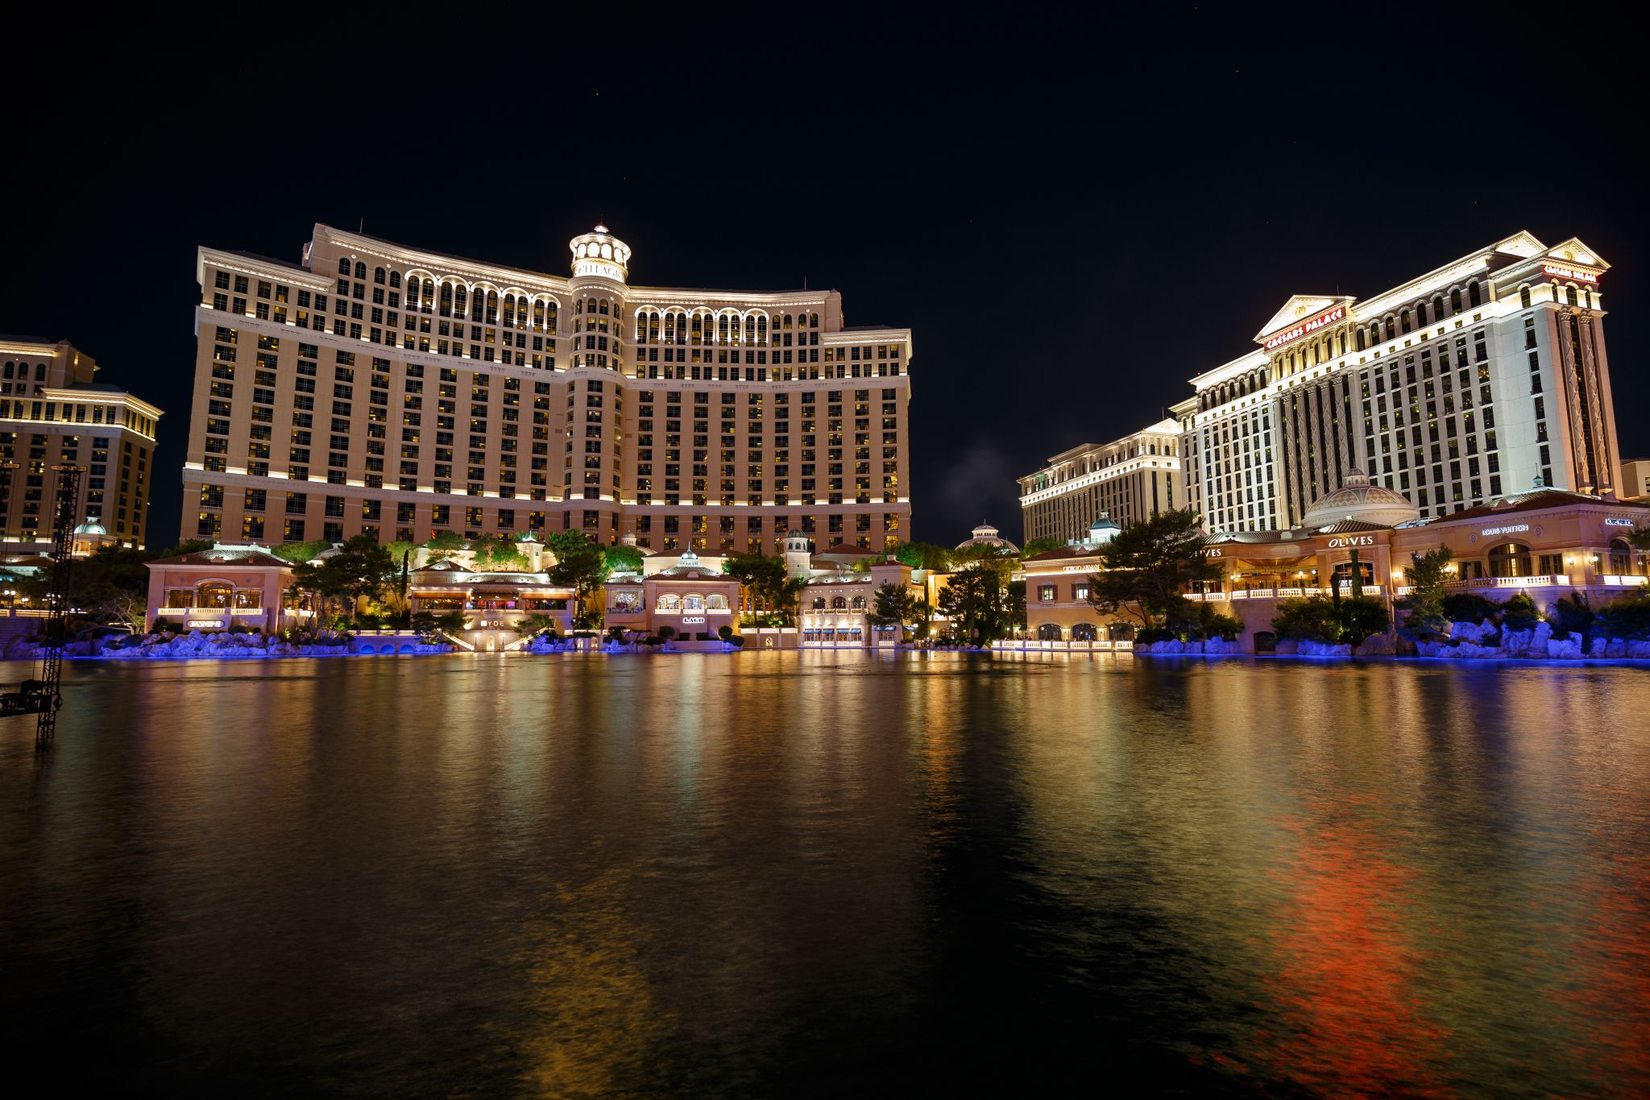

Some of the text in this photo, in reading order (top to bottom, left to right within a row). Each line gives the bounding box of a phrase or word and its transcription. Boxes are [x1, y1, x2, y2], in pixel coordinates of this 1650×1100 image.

[1544, 265, 1597, 283] CAESARS PALACE
[1266, 309, 1343, 349] CAESARS PALACE
[1482, 524, 1529, 536] LOUIS VUITTON
[1328, 535, 1374, 548] OLIVES
[683, 616, 706, 624] LAGO
